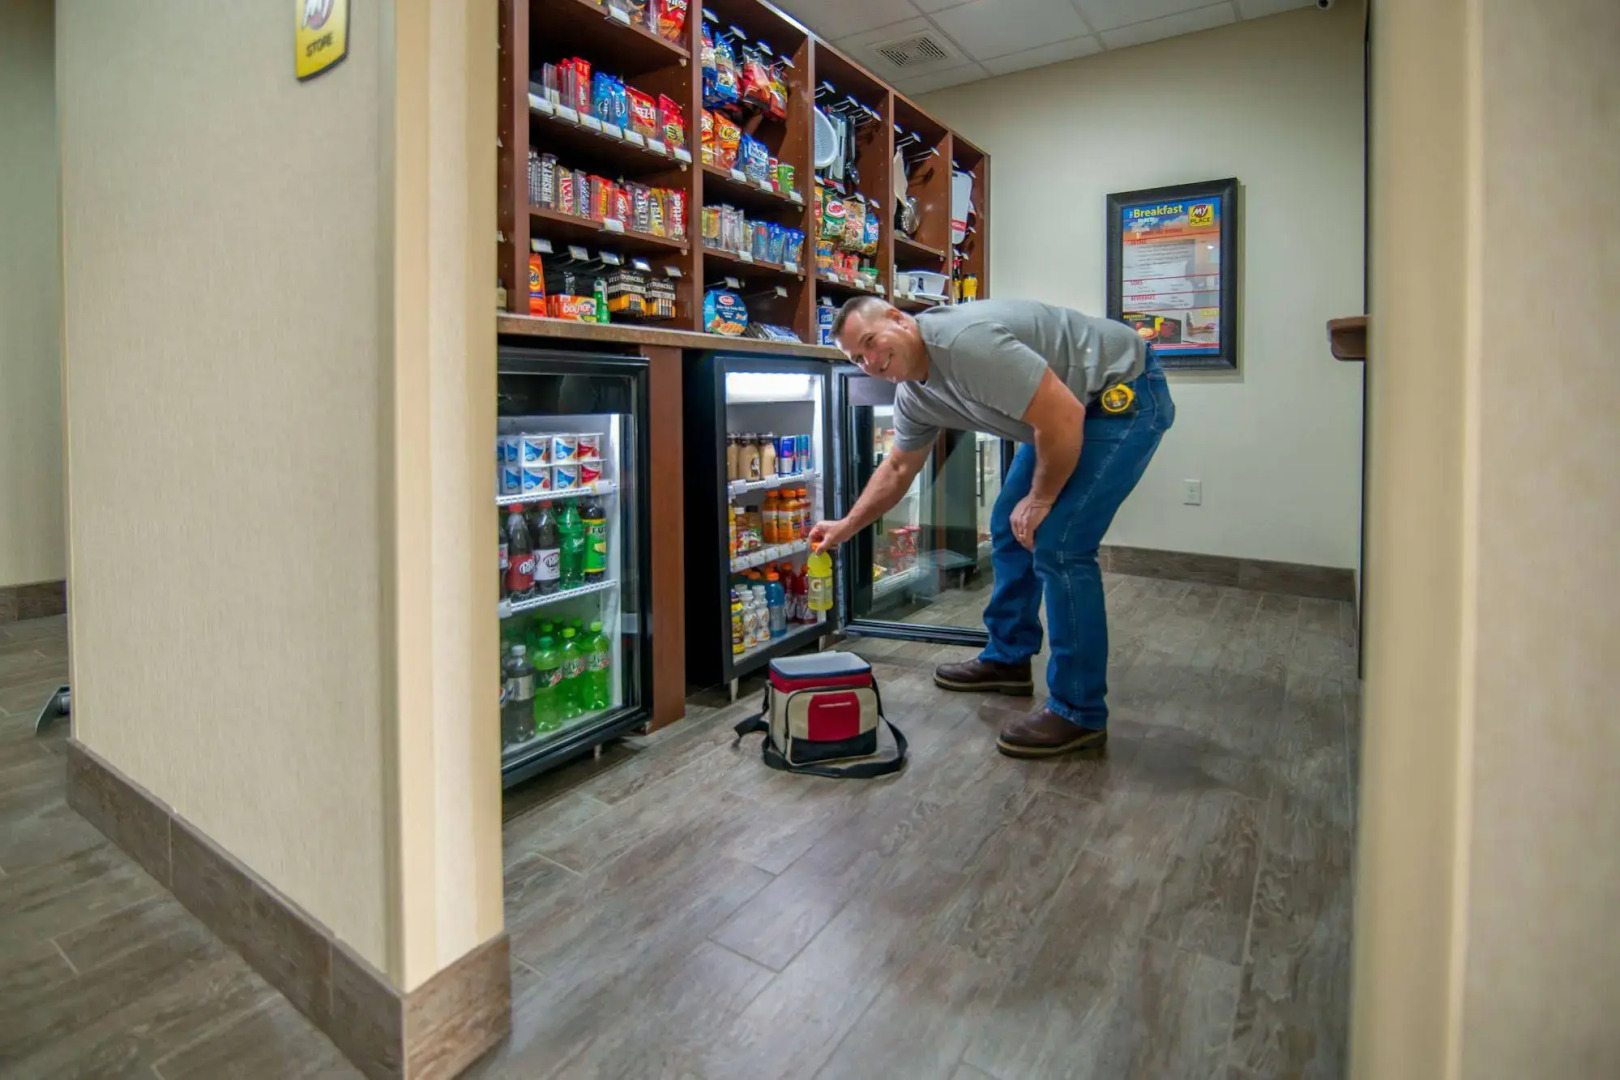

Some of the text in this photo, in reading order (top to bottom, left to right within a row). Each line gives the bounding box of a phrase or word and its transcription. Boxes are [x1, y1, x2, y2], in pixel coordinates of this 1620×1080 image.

[1134, 204, 1183, 218] Breakfast
[621, 273, 644, 284] DURACELL
[652, 281, 674, 291] DURACELL
[563, 302, 591, 315] bounce
